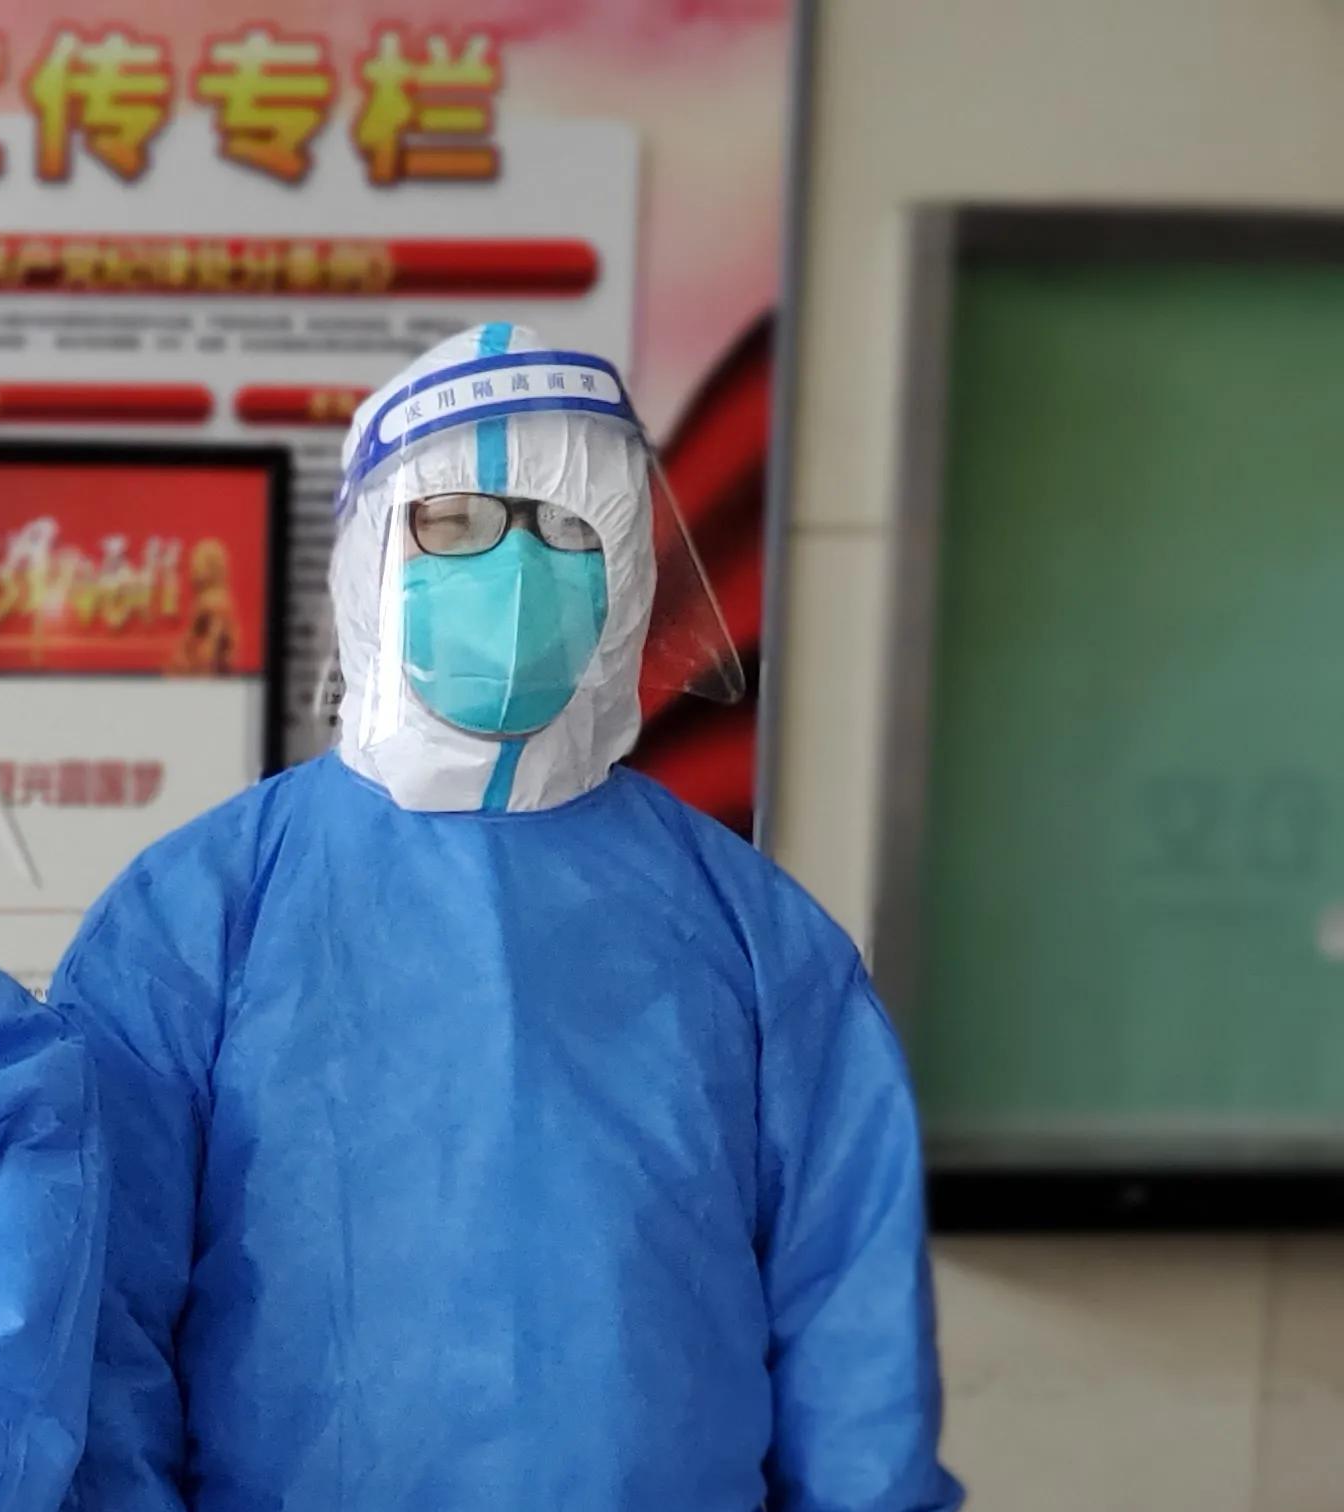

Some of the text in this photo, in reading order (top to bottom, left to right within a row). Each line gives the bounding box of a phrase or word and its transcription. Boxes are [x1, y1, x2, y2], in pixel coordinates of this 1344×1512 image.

[404, 371, 598, 425] 医用隔离面罩
